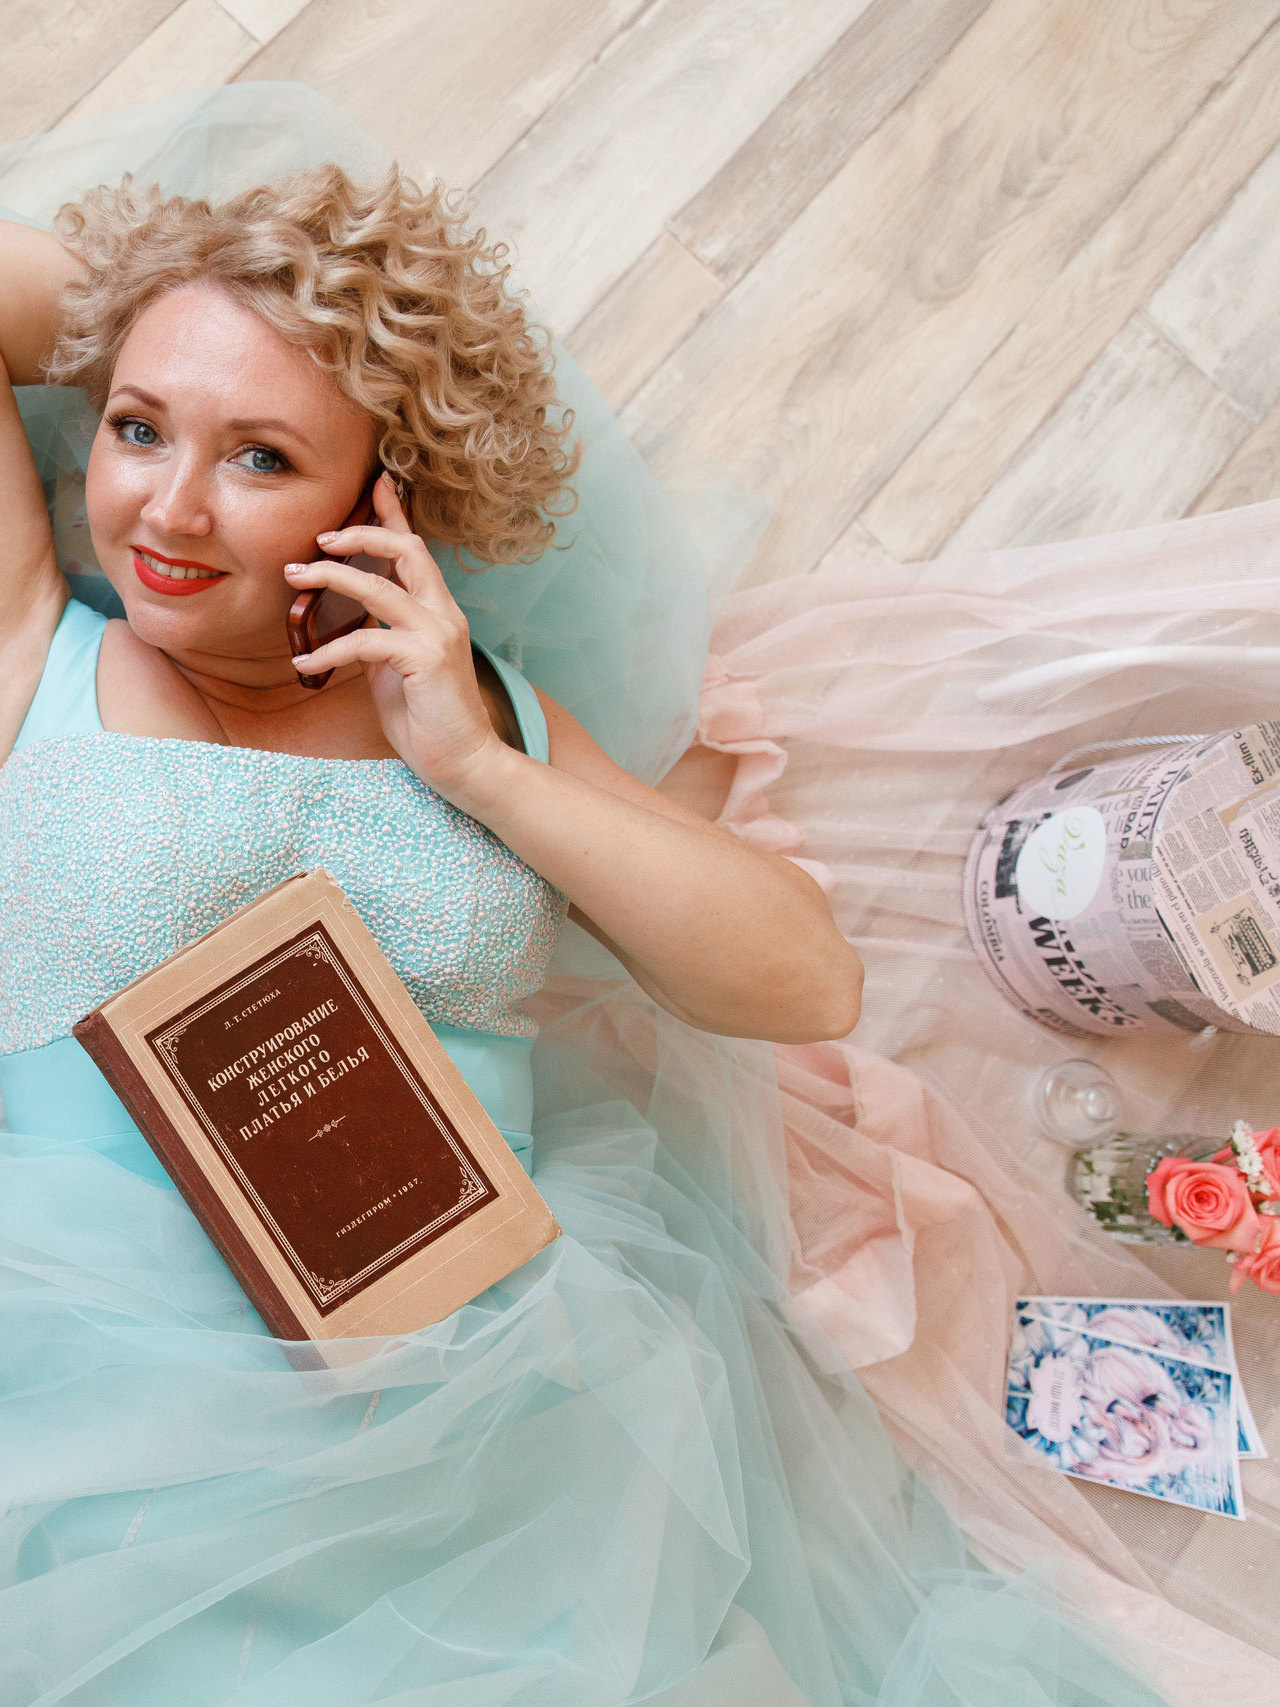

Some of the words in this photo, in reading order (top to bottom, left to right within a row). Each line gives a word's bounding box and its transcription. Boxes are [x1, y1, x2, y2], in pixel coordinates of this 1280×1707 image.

[1239, 741, 1265, 785] Ex-film
[1136, 769, 1179, 840] DAILY
[1127, 889, 1152, 909] the
[1160, 876, 1178, 903] piano
[981, 880, 1005, 962] COLOMBIA
[1185, 923, 1201, 946] unen
[1196, 946, 1205, 957] se
[1203, 957, 1229, 1001] Venezuela
[224, 1020, 234, 1030] Л.
[233, 1014, 242, 1024] Т.
[241, 988, 282, 1018] СТЕТЮХА
[207, 998, 339, 1093] КОНСТРУИРОВАНИЕ
[246, 1033, 321, 1091] ЖЕНСКОГО
[239, 1091, 303, 1142] ПЛАТЬЯ
[302, 1081, 317, 1098] И
[317, 1046, 370, 1089] БЕЛЬЯ
[257, 1049, 331, 1107] ЛЕГКОГО
[335, 1196, 392, 1238] ГИЗЛЕГПРОМ
